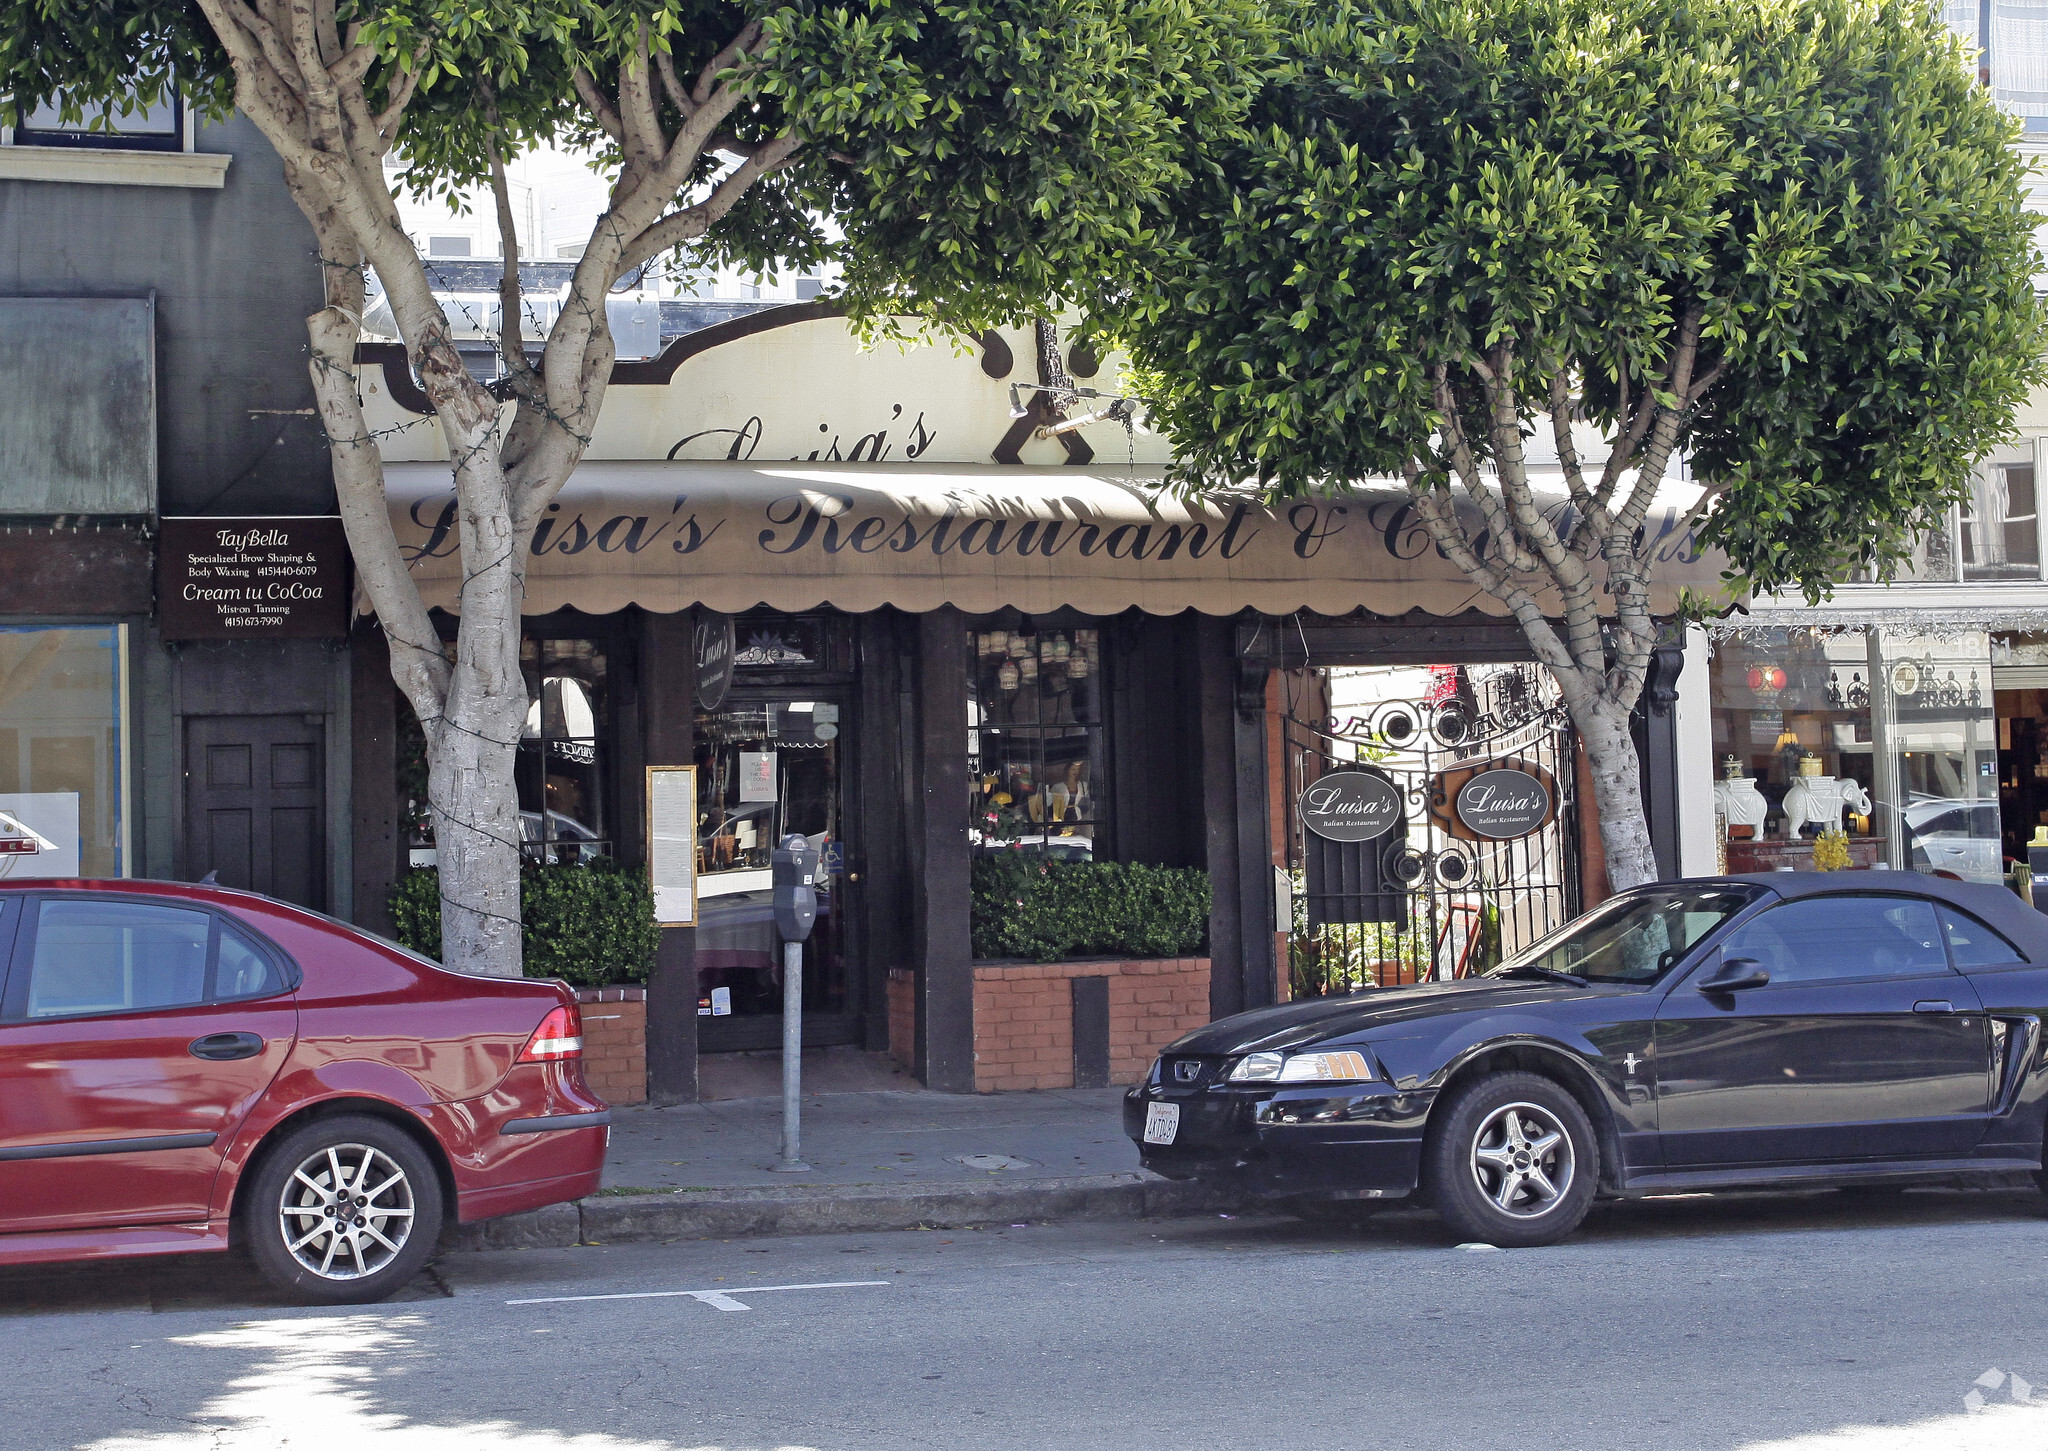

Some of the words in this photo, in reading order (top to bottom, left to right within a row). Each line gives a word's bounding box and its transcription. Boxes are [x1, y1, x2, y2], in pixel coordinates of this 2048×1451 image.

[758, 493, 1261, 561] Restaurant
[1288, 503, 1347, 560] &
[216, 528, 289, 552] TayBella
[188, 553, 237, 565] Specialized
[241, 553, 264, 563] Brow
[267, 553, 303, 564] Shaping
[306, 552, 316, 563] &
[188, 567, 212, 578] Body
[215, 566, 249, 578] Waxing
[257, 566, 317, 577] (415)440-6079
[183, 582, 241, 601] Cream
[245, 586, 263, 600] tu
[267, 582, 323, 600] CoCoa
[217, 604, 250, 614] Mist-on
[254, 604, 290, 614] Tanning
[1307, 787, 1393, 815] Luisa's
[1465, 784, 1542, 813] Luisa's
